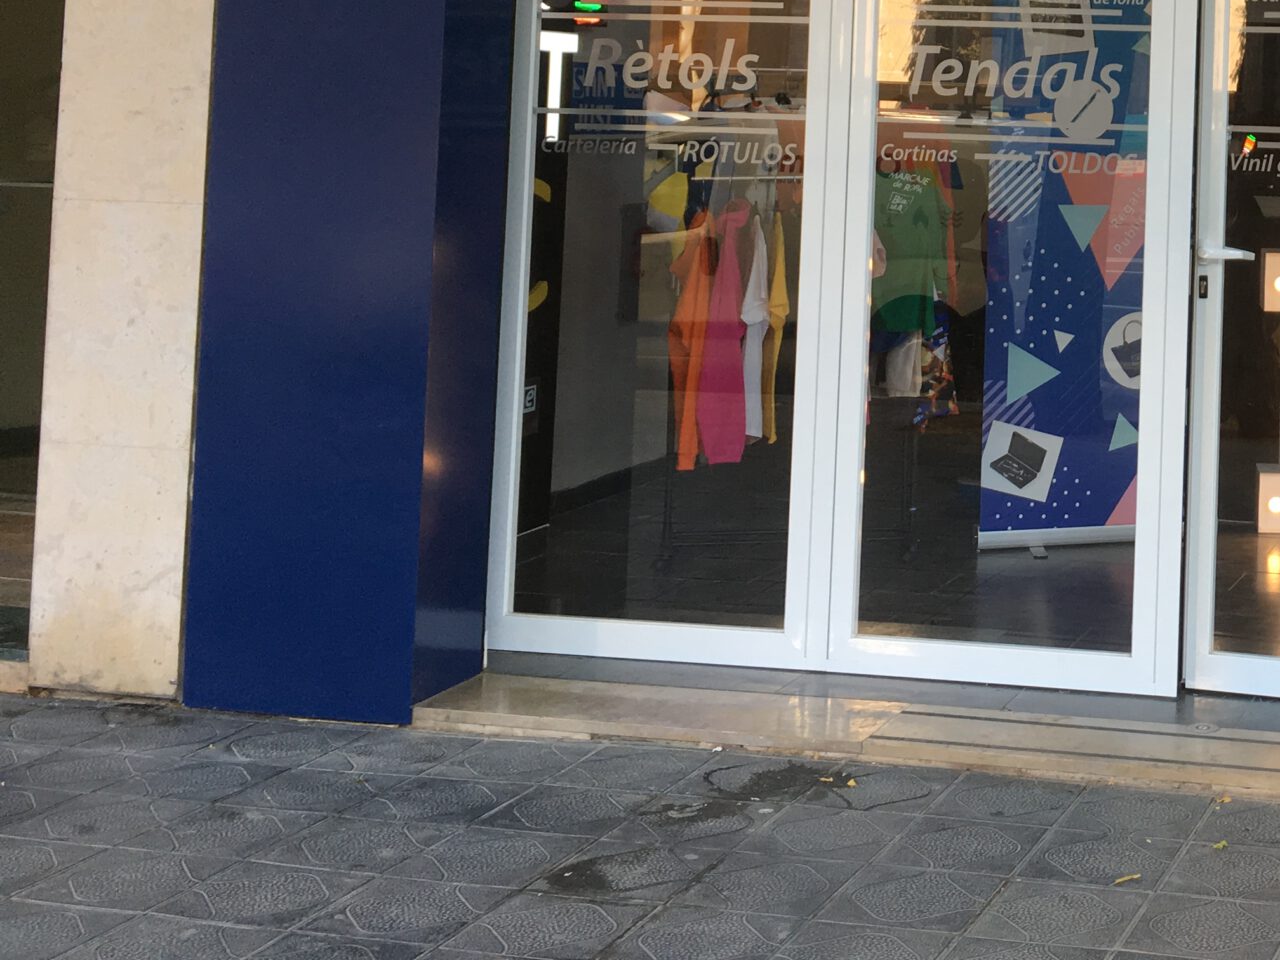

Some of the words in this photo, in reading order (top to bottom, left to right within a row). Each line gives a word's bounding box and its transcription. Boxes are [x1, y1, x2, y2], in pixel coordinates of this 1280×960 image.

[584, 38, 760, 91] Rètols
[909, 45, 1123, 100] Tendals
[541, 136, 637, 155] Cartelería
[684, 137, 797, 165] RÓTULOS
[880, 143, 958, 163] Cortinas
[1229, 153, 1273, 172] Vinil
